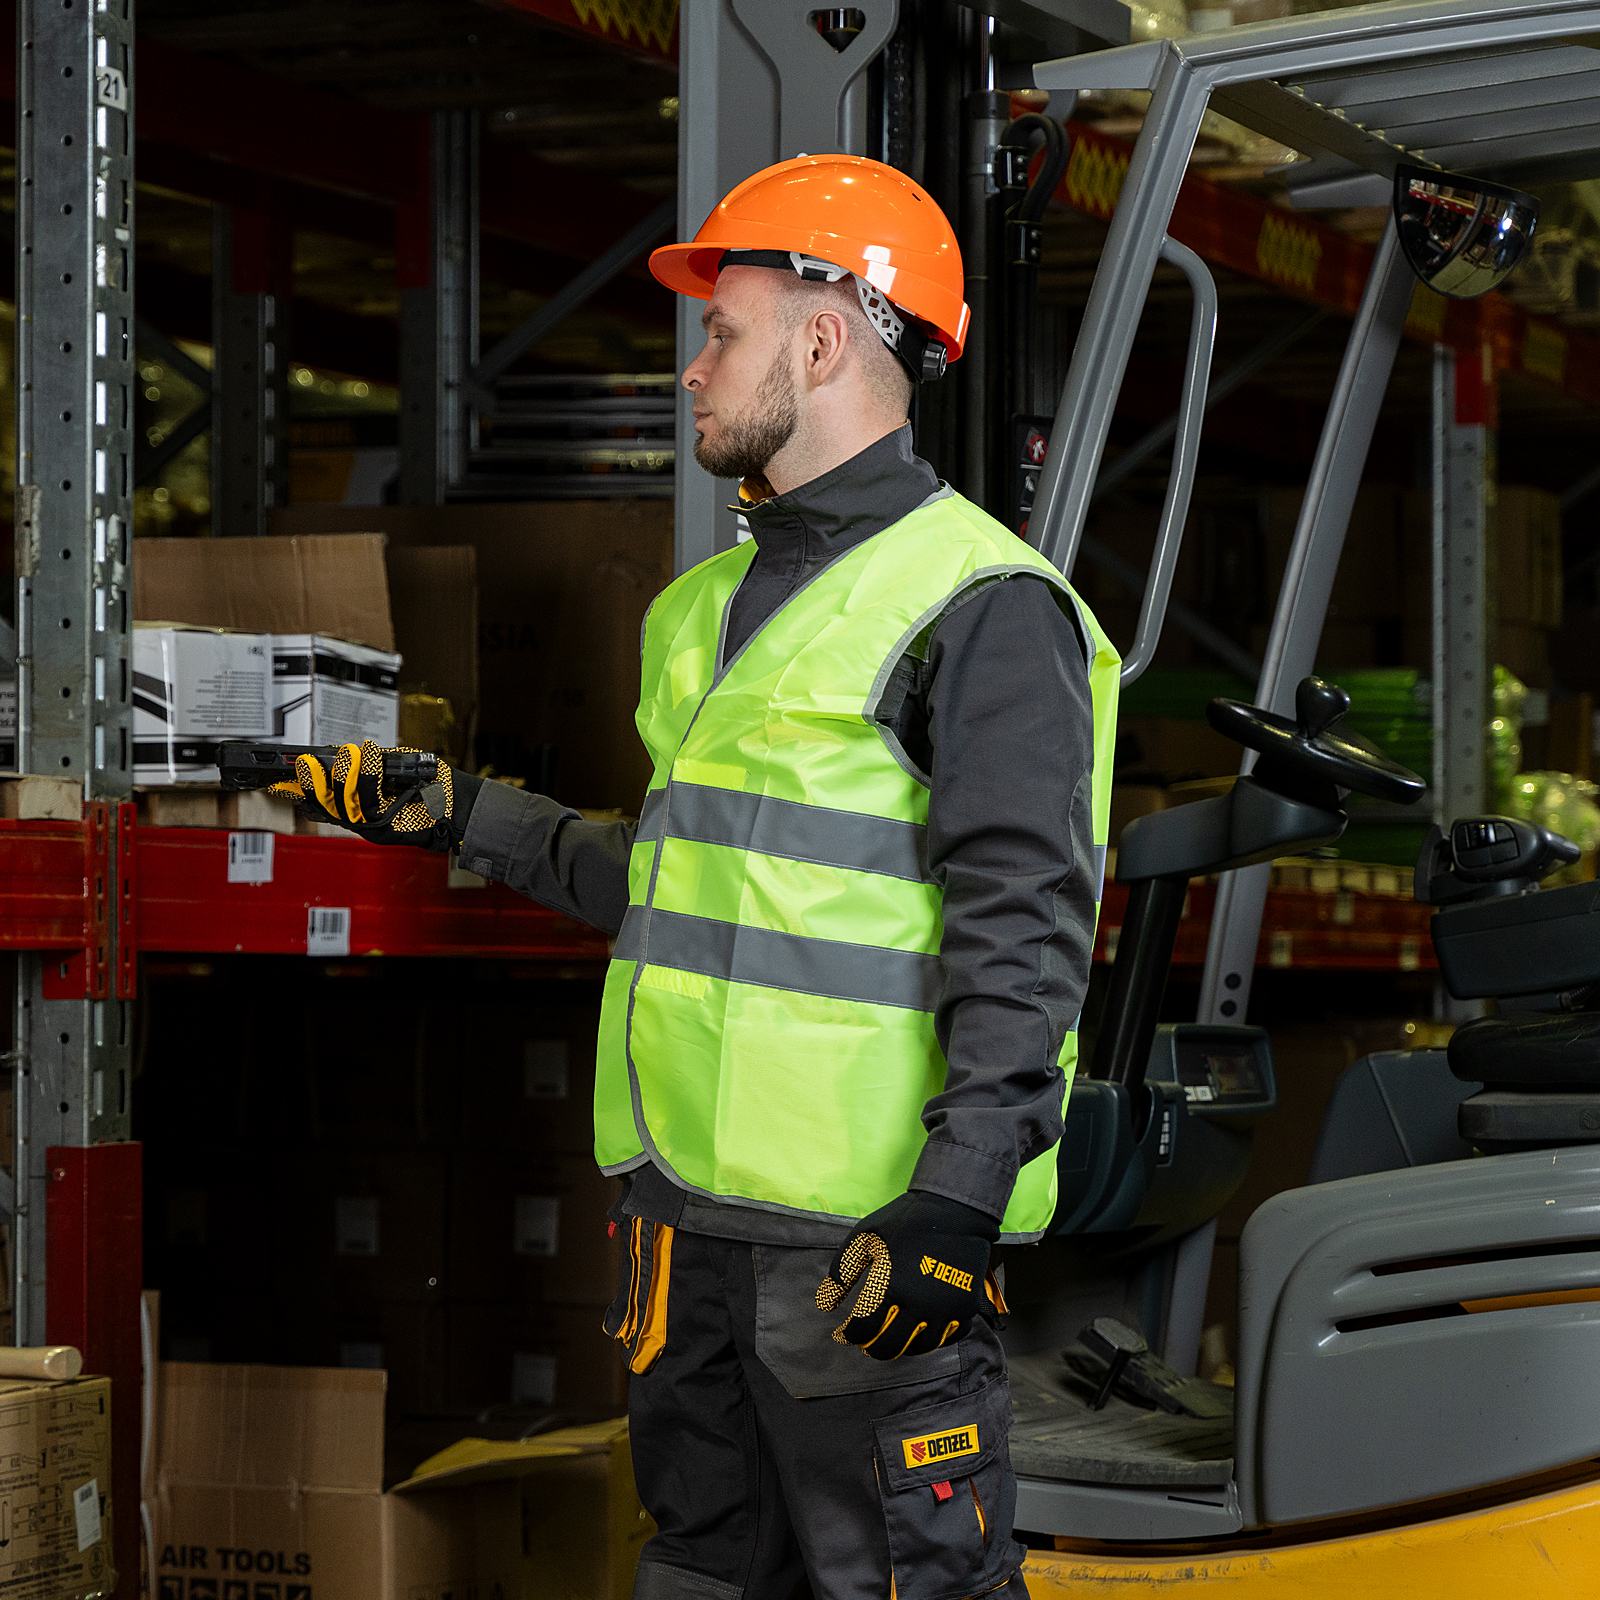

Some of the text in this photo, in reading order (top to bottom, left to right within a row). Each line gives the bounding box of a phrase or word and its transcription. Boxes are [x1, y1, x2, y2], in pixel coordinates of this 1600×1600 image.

[103, 74, 118, 100] 21
[933, 1261, 974, 1292] DENZEL
[927, 1431, 973, 1458] DENZEL
[159, 1545, 311, 1575] AIR TOOLS
